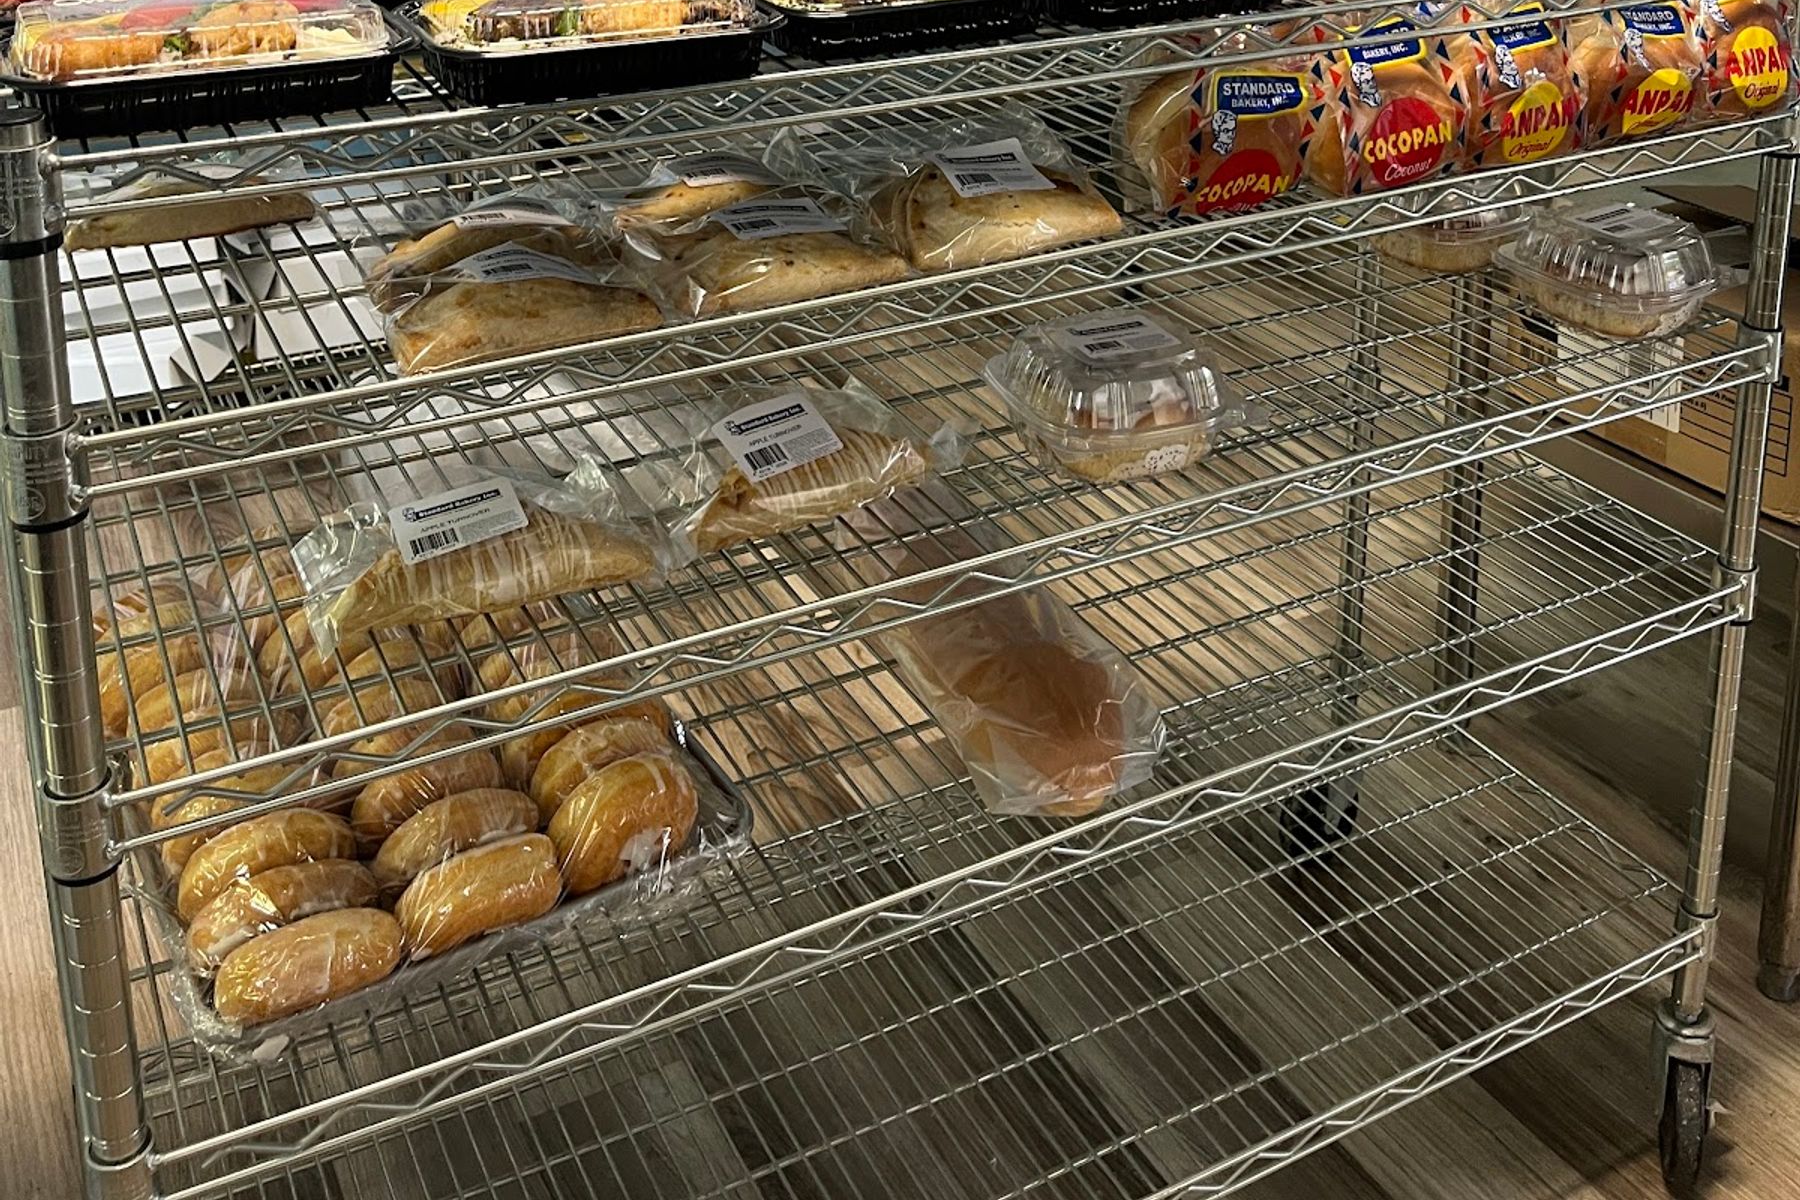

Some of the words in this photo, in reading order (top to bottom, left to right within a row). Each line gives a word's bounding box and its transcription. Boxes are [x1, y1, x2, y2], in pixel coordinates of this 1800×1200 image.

[1725, 44, 1790, 80] ANPAN
[1222, 80, 1296, 97] STANDARD
[1620, 88, 1695, 117] ANPAN
[1744, 82, 1781, 101] Original
[1501, 96, 1581, 140] ANPAN
[1363, 120, 1453, 163] COCOPAN
[1196, 173, 1291, 202] COCOPAN
